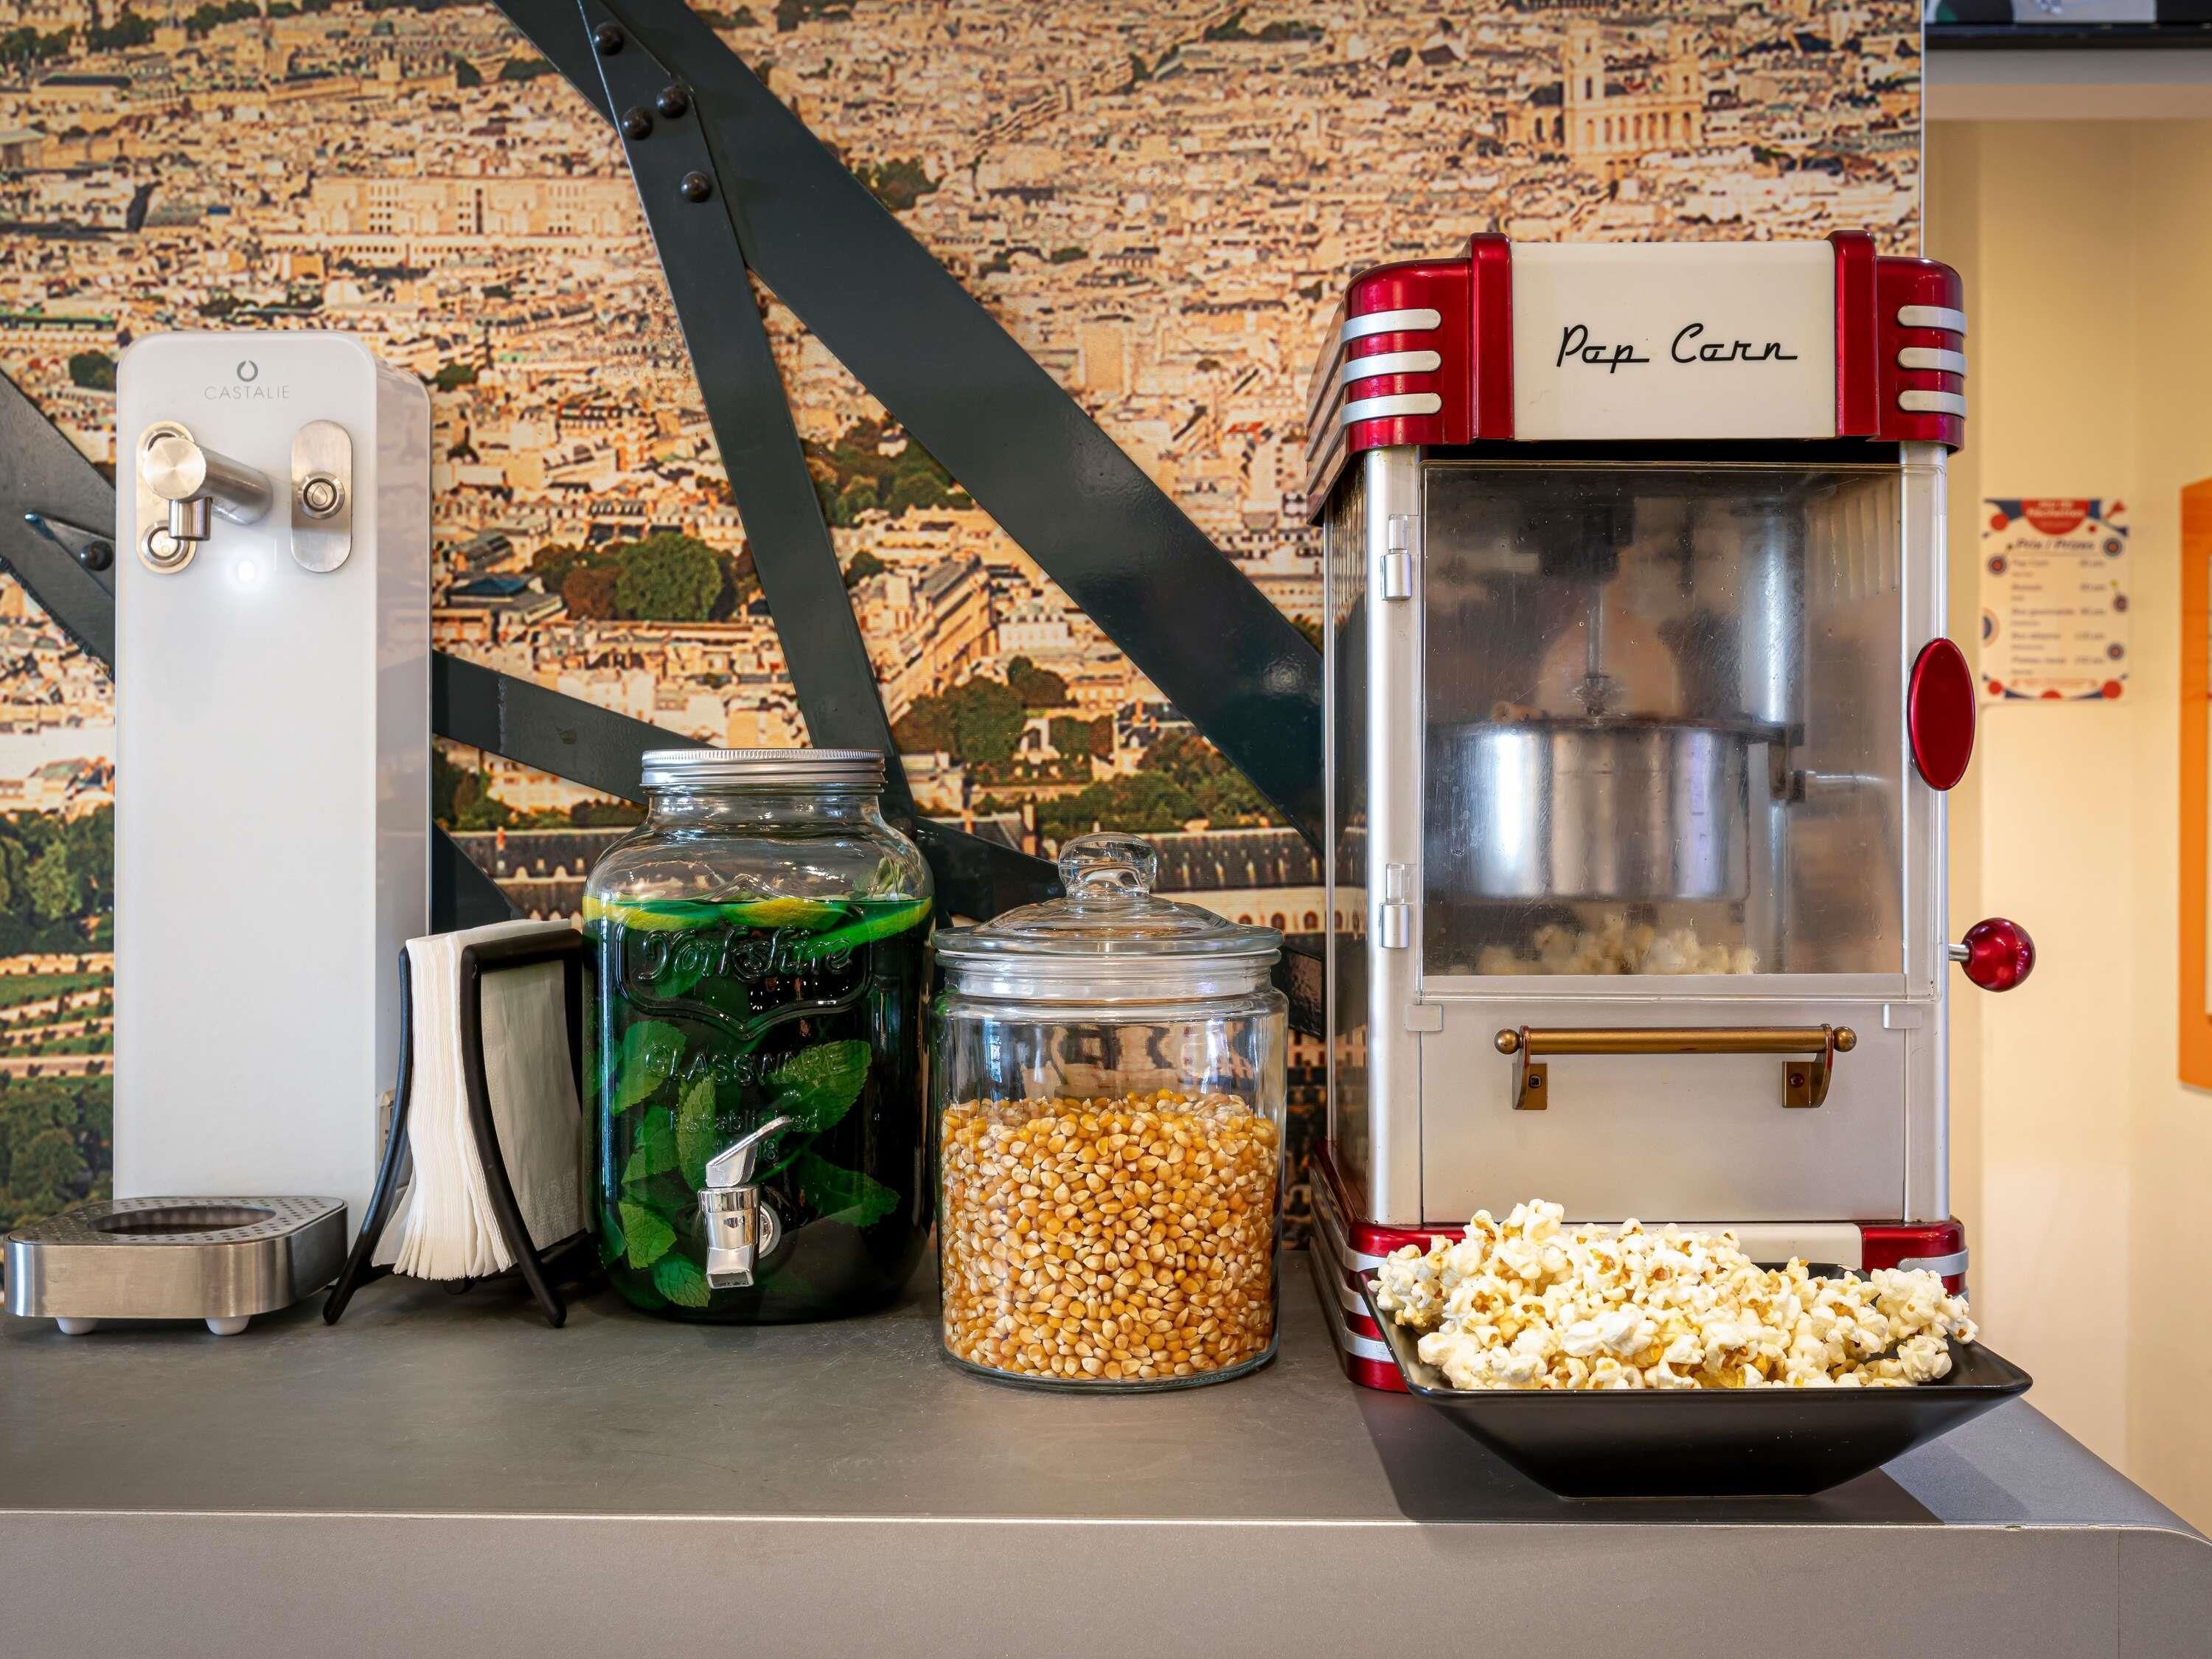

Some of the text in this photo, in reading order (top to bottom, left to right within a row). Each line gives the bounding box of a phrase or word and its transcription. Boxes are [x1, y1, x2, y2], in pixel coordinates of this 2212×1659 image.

[1556, 322, 1798, 374] Pop Corn
[204, 385, 290, 400] CASTALIE
